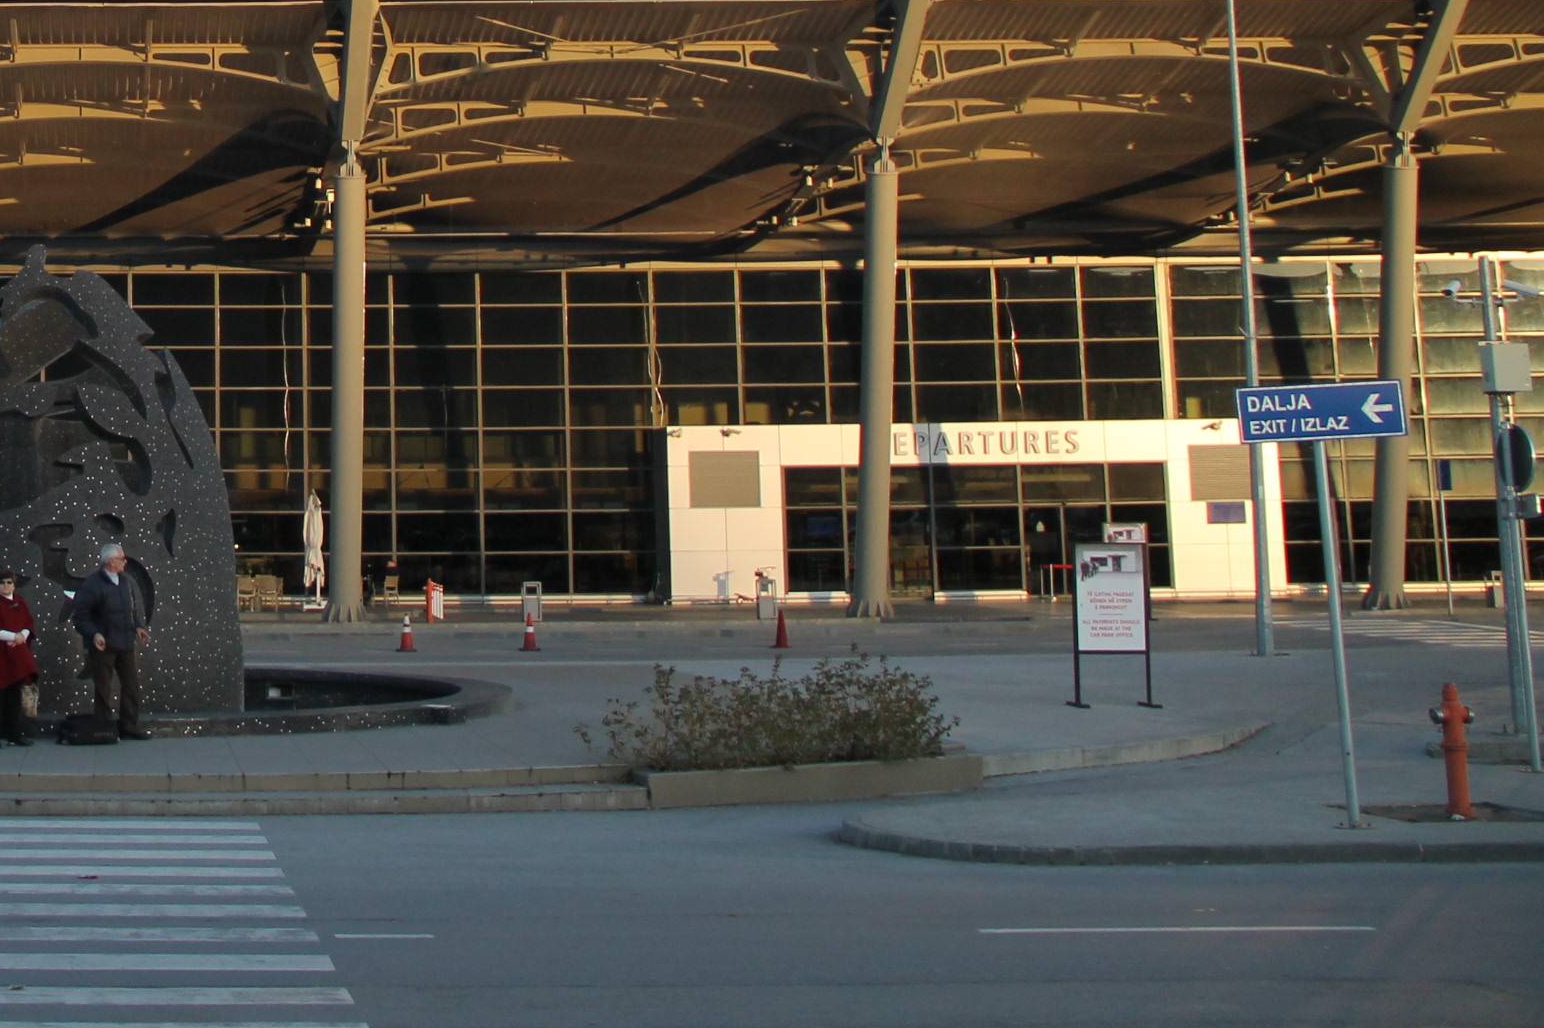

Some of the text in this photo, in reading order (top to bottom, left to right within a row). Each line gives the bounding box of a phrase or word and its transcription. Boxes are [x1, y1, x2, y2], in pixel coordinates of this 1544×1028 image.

[1246, 393, 1312, 413] DALJA
[1249, 418, 1287, 435] EXIT
[1300, 416, 1350, 433] IZLAZ
[893, 430, 1080, 456] EPARTURES
